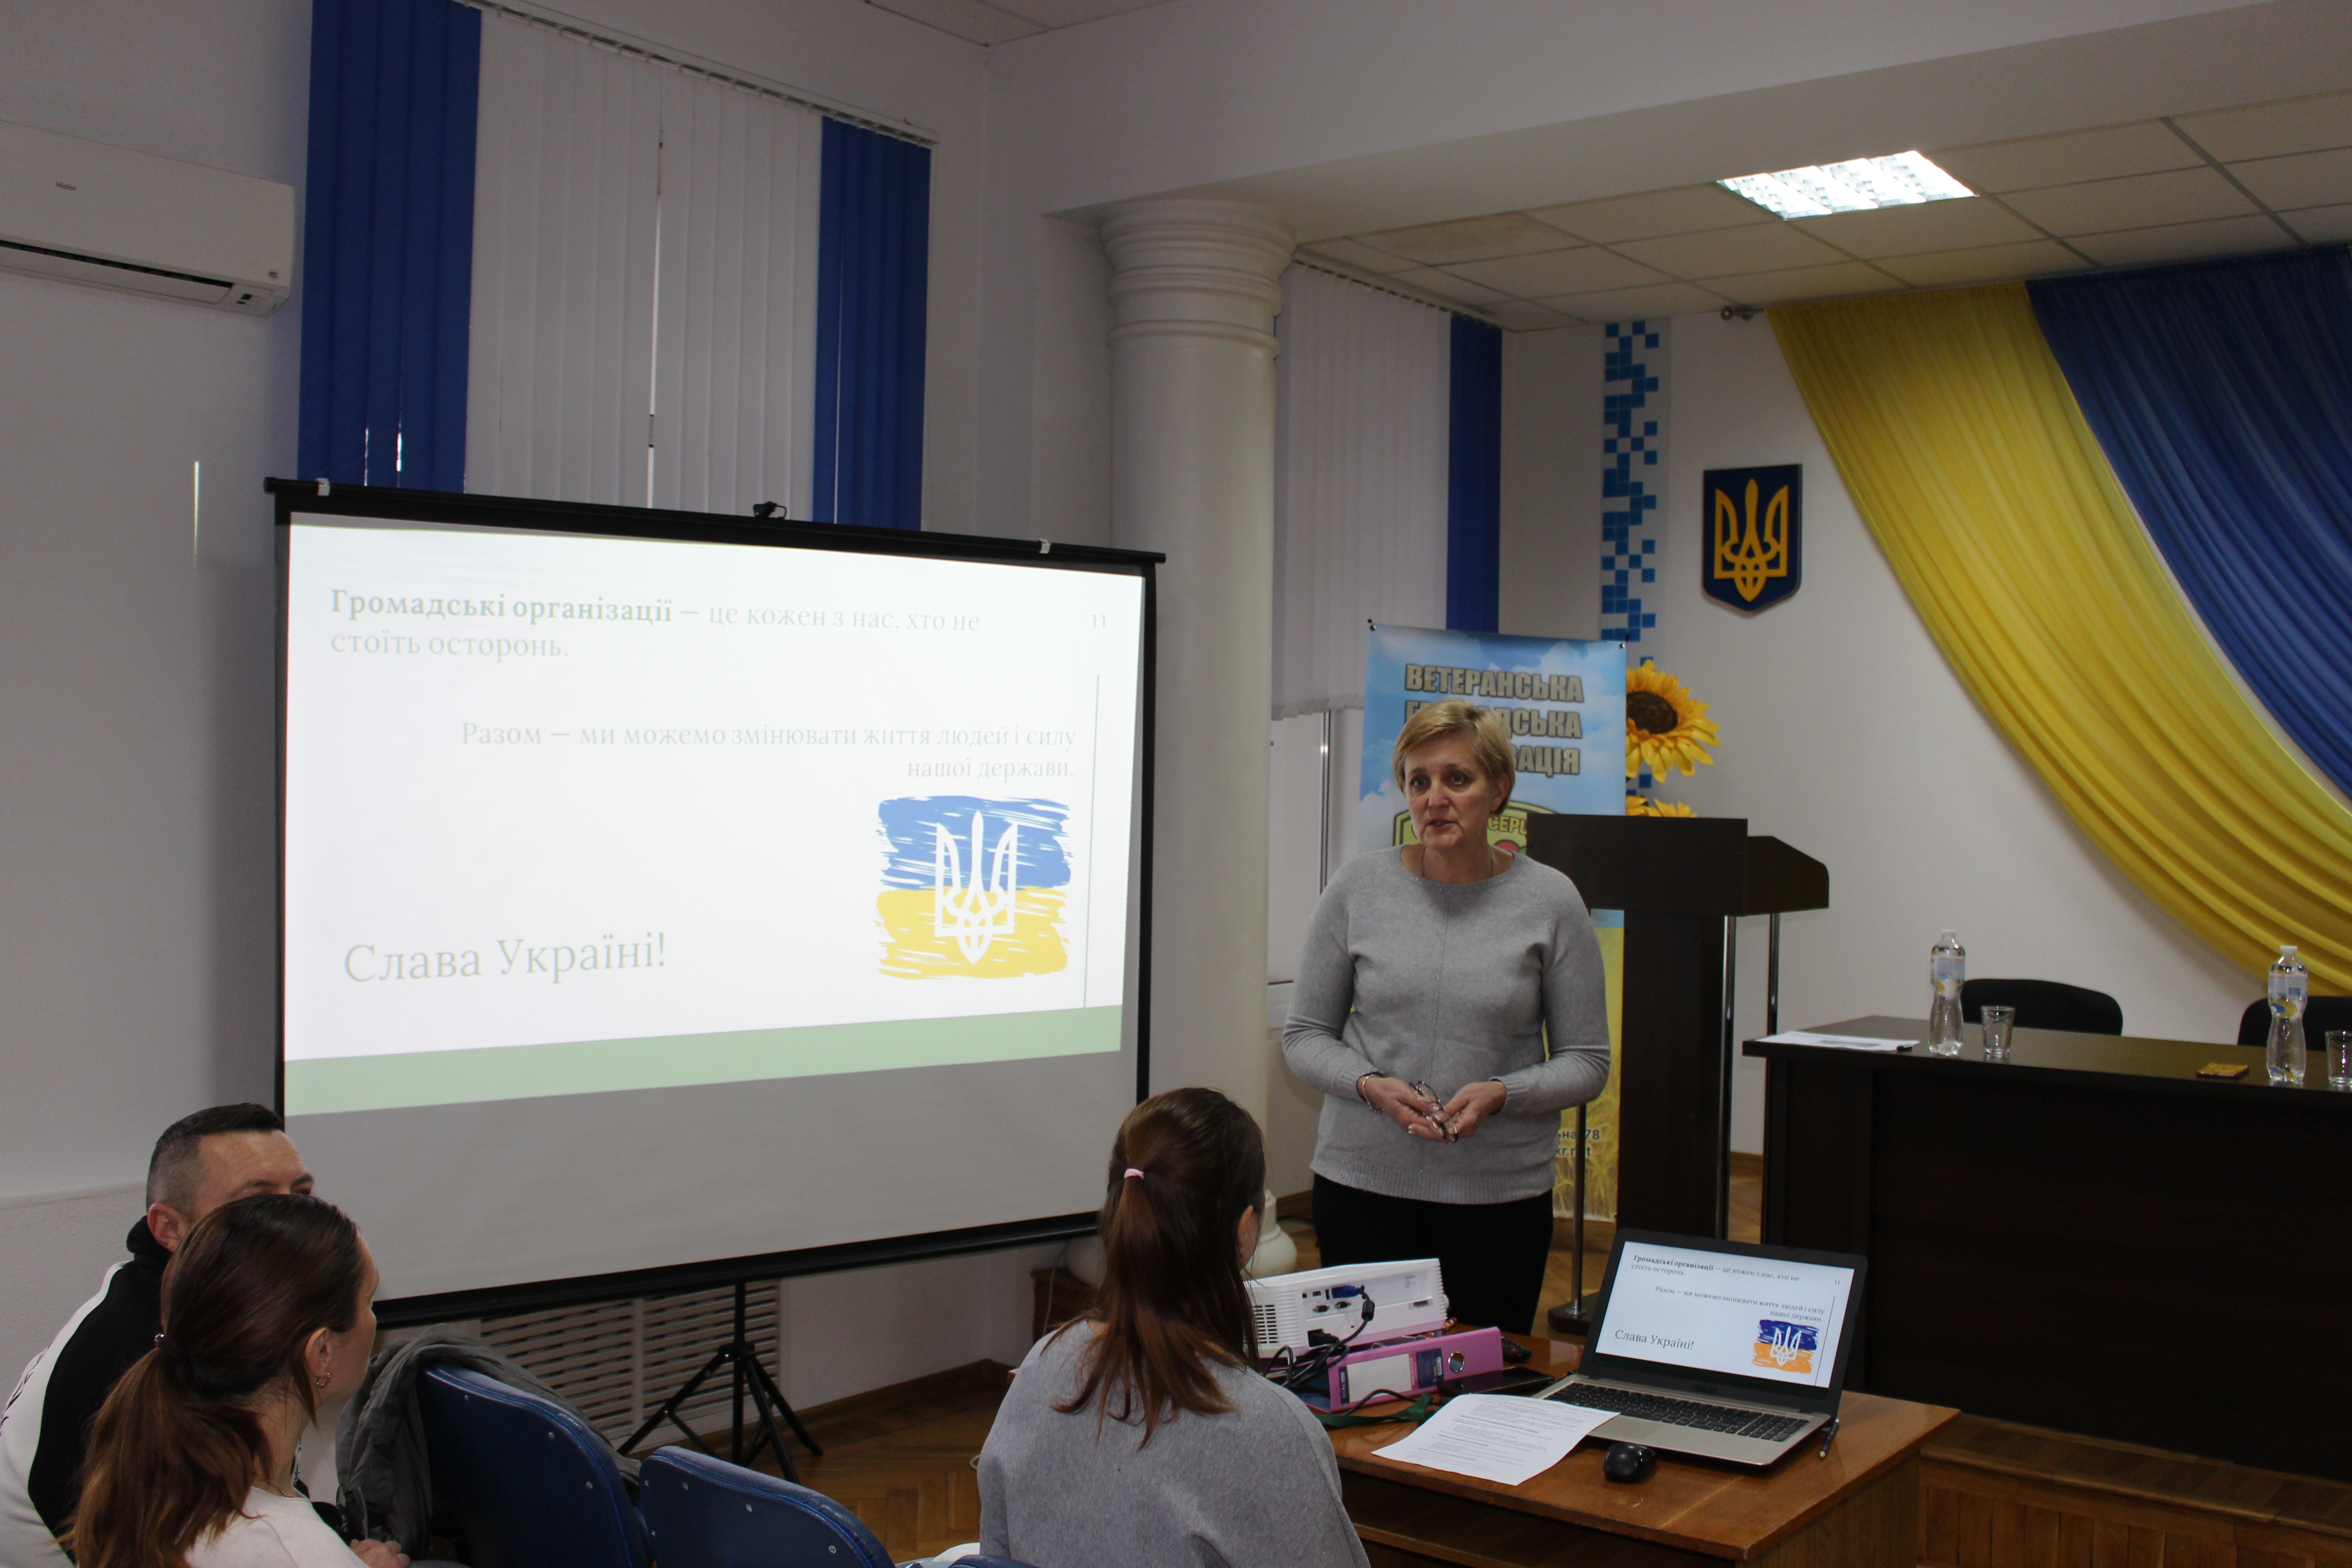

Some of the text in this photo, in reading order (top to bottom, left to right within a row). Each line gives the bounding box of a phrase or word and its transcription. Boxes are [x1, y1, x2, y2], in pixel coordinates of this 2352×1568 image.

[56, 181, 76, 191] Haier
[331, 589, 505, 621] Громадські
[512, 596, 672, 626] організації
[709, 608, 738, 627] це
[747, 608, 825, 627] кожен
[832, 611, 844, 627] з
[852, 612, 899, 631] нас,
[906, 614, 945, 630] хто
[953, 615, 980, 632] не
[1093, 614, 1106, 628] 11
[329, 629, 568, 664] стоїть осторонь.
[1406, 664, 1584, 703] ВЕТЕРАНСЬКА
[462, 722, 541, 745] Разом
[580, 729, 614, 745] ми
[623, 729, 726, 745] можемо
[731, 724, 856, 745] змінювати
[862, 730, 930, 745] життя
[936, 726, 1008, 747] людей
[1014, 725, 1019, 745] і
[1026, 731, 1076, 752] силу
[907, 757, 1073, 784] нашої держави.
[1513, 745, 1580, 778] АЦІЯ
[343, 931, 664, 984] Слава Україні!
[1633, 1255, 1673, 1266] Громадські
[1674, 1261, 1714, 1271] організації
[1652, 1267, 1686, 1276] осторонь.
[1655, 1286, 1675, 1294] Разом
[1694, 1292, 1721, 1300] можемо
[1722, 1296, 1758, 1305] змінювати
[1780, 1303, 1803, 1312] людей
[1791, 1313, 1823, 1323] держави.
[1615, 1329, 1694, 1350] Слава Україні!
